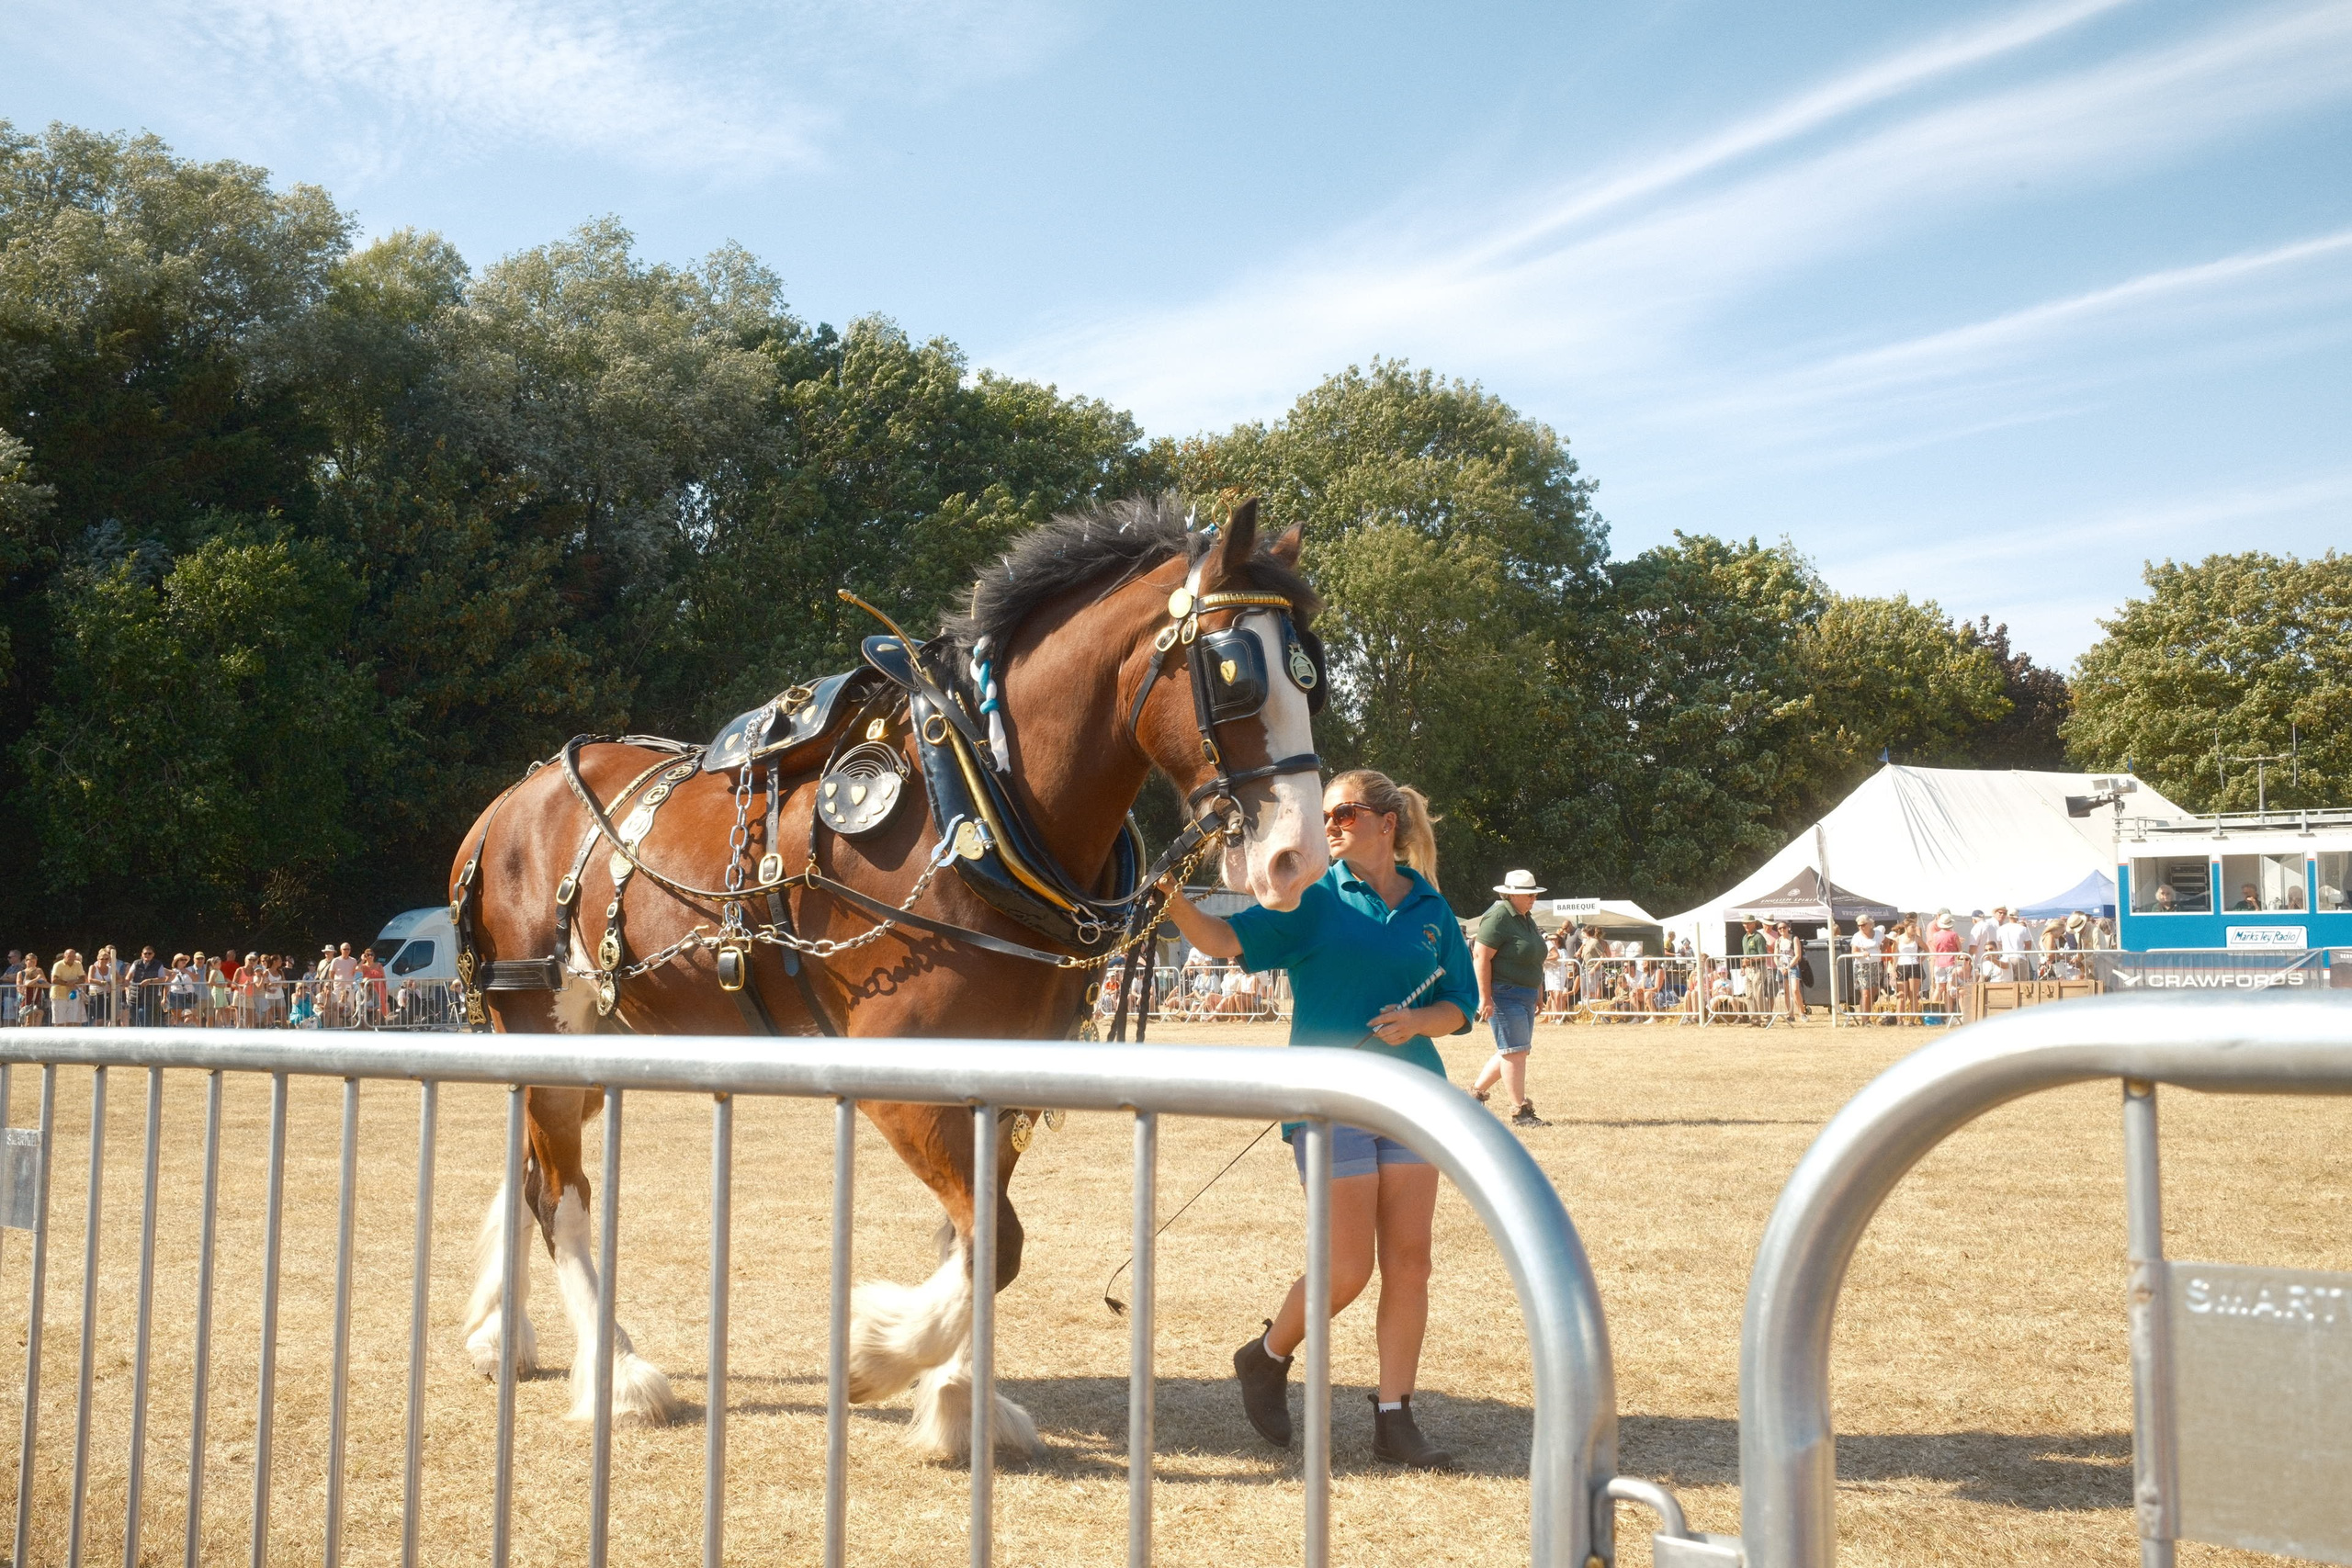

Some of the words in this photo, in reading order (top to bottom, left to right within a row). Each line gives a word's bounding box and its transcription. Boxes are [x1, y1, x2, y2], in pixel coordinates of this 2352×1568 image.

[1556, 903, 1596, 911] BARBEQUE
[2234, 931, 2258, 942] Marks
[2259, 931, 2273, 943] Tey
[2274, 931, 2296, 942] Radio
[2148, 972, 2304, 988] CRAWFORDS
[2186, 1278, 2343, 1323] SMART
